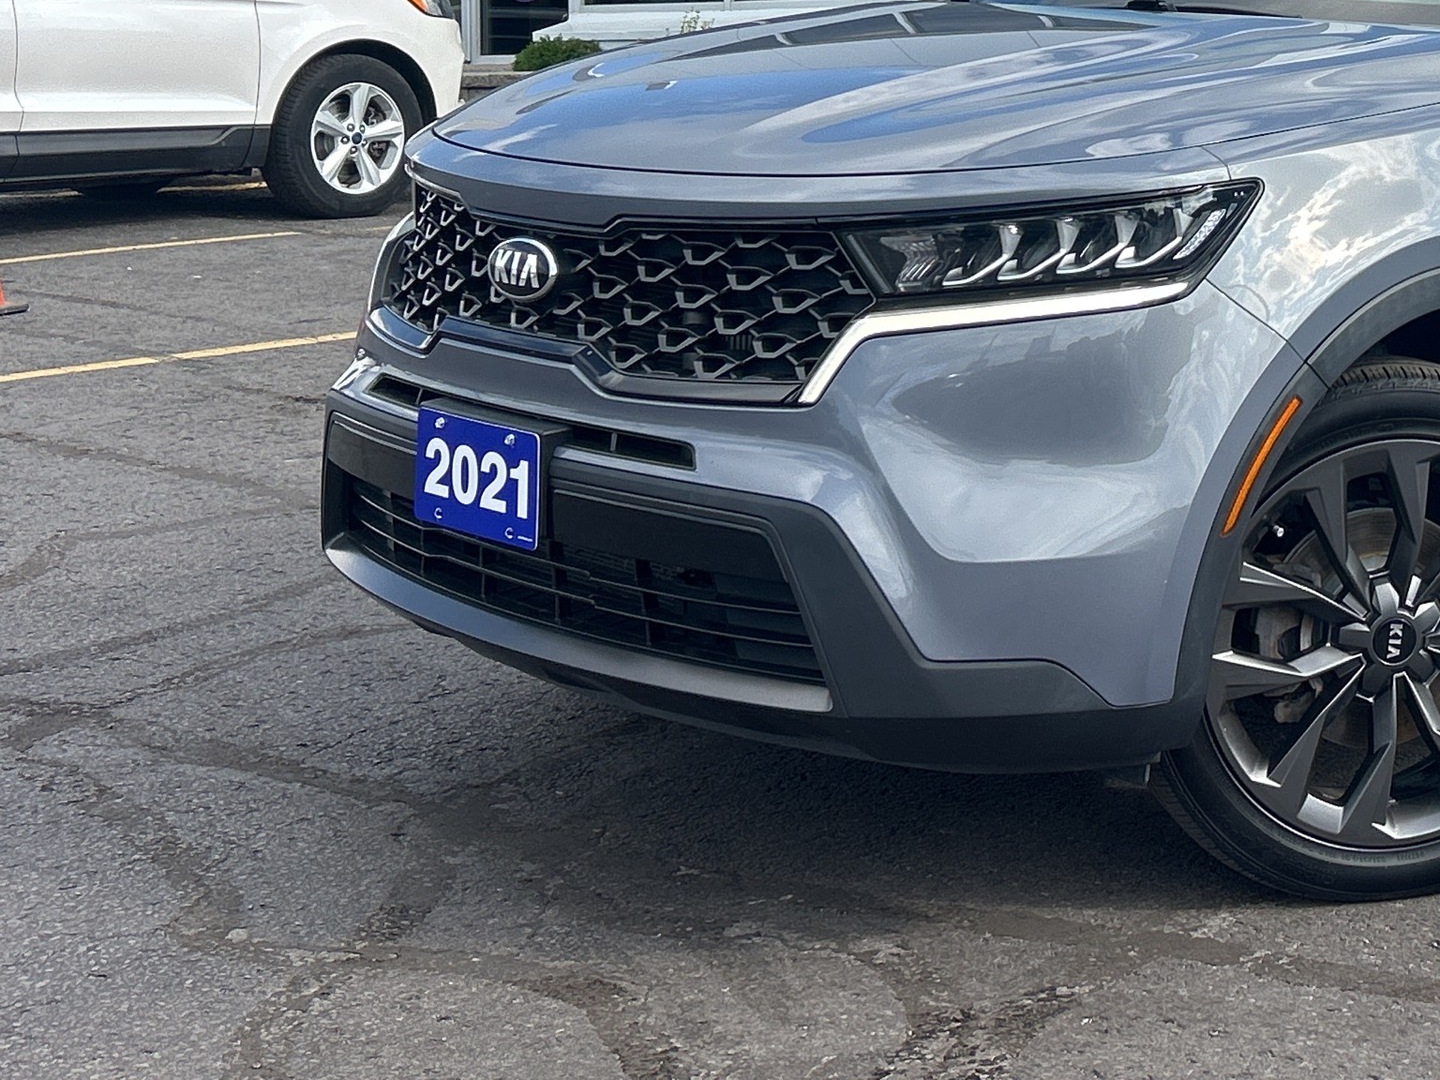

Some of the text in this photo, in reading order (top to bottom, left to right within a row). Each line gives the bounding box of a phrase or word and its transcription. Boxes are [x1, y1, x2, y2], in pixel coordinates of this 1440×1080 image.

[494, 249, 540, 289] KIA
[424, 437, 529, 520] 2021
[1386, 623, 1404, 659] KIA
